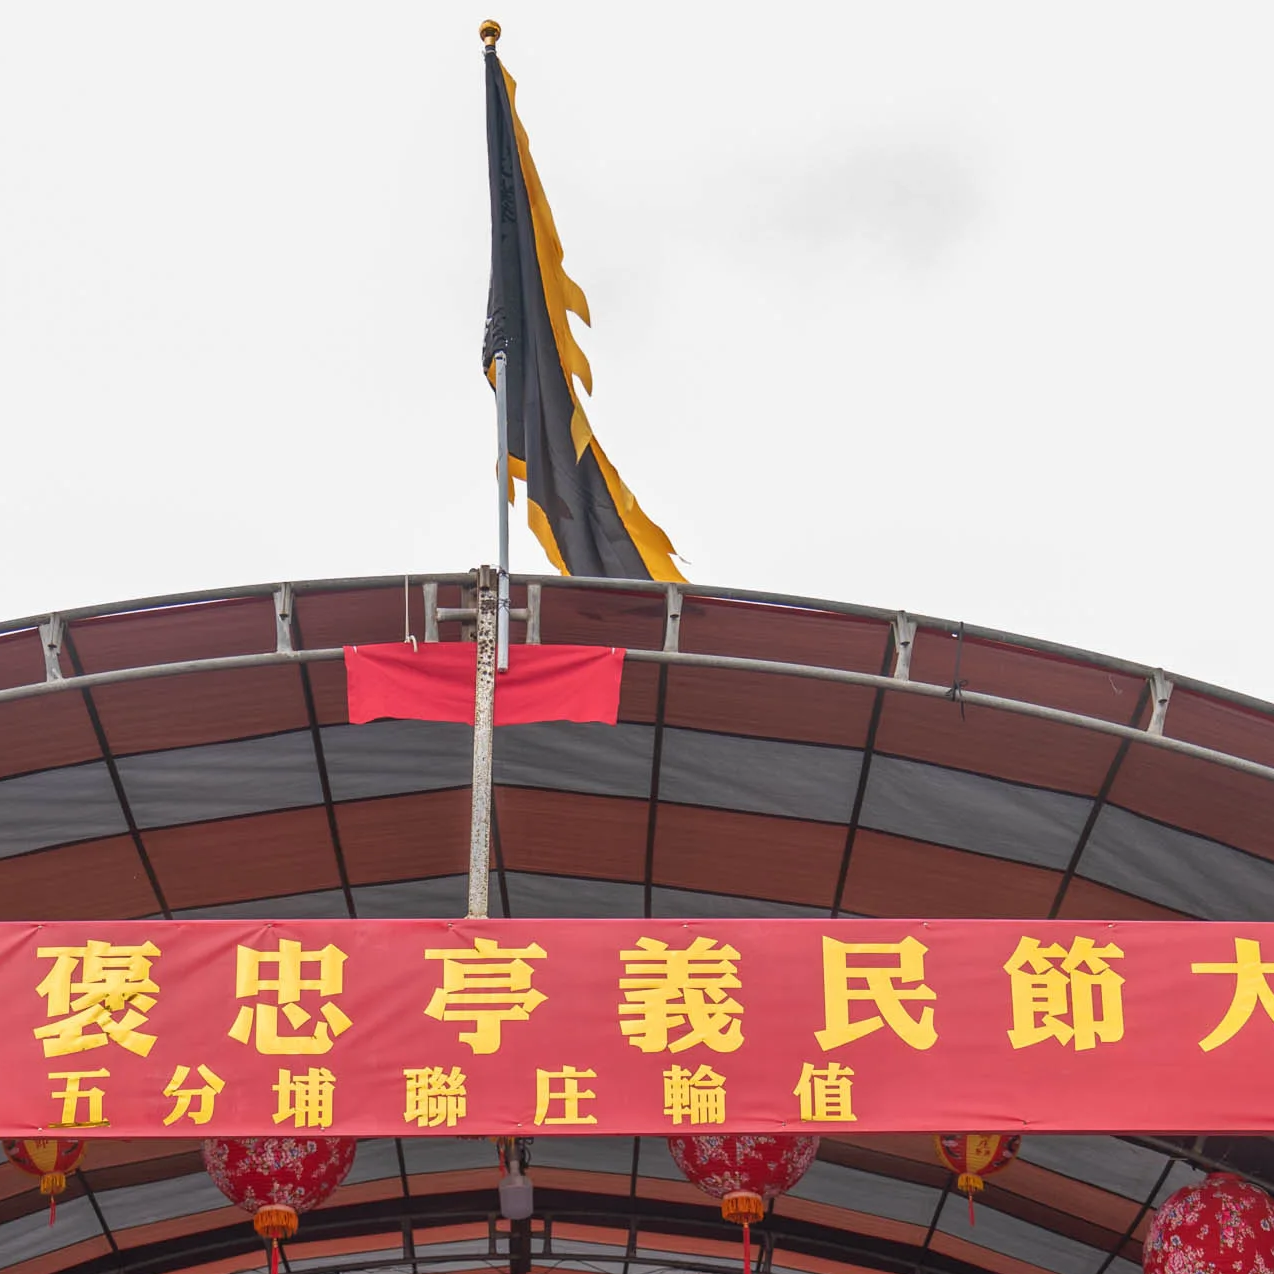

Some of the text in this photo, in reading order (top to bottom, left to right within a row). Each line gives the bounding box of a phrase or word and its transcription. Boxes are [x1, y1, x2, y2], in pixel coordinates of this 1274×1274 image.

[49, 1063, 856, 1127] 五分埔聯庄輪值
